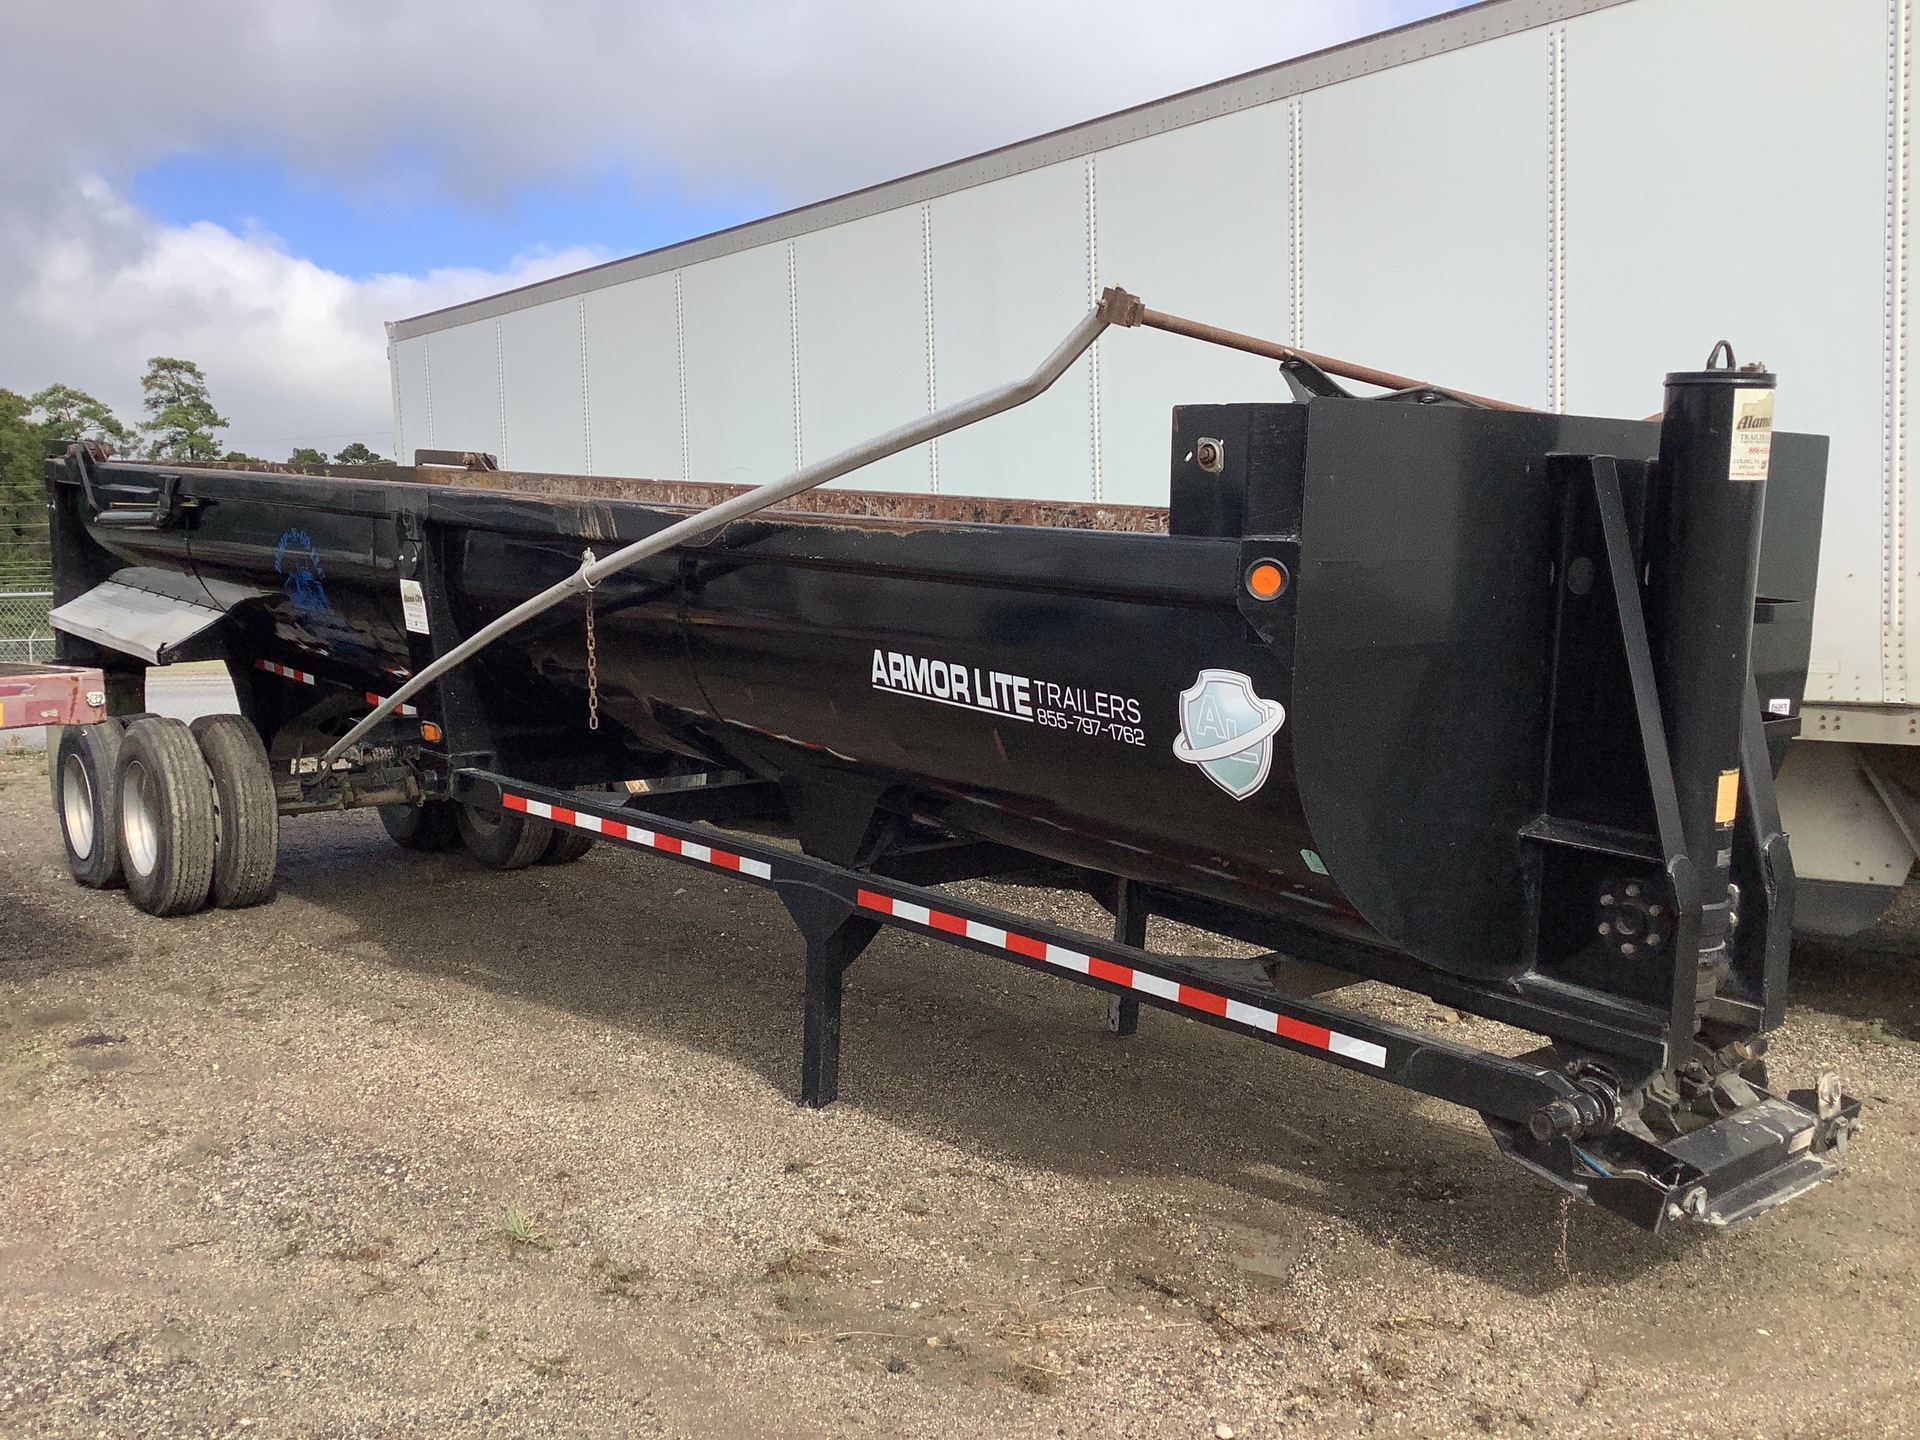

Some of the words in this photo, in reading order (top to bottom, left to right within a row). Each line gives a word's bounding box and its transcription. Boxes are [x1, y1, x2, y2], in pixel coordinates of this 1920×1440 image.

[871, 649, 970, 703] ARMOR
[974, 667, 1033, 717] LITE
[1033, 679, 1142, 724] TRAILERS
[1037, 708, 1146, 746] 855-797-1762
